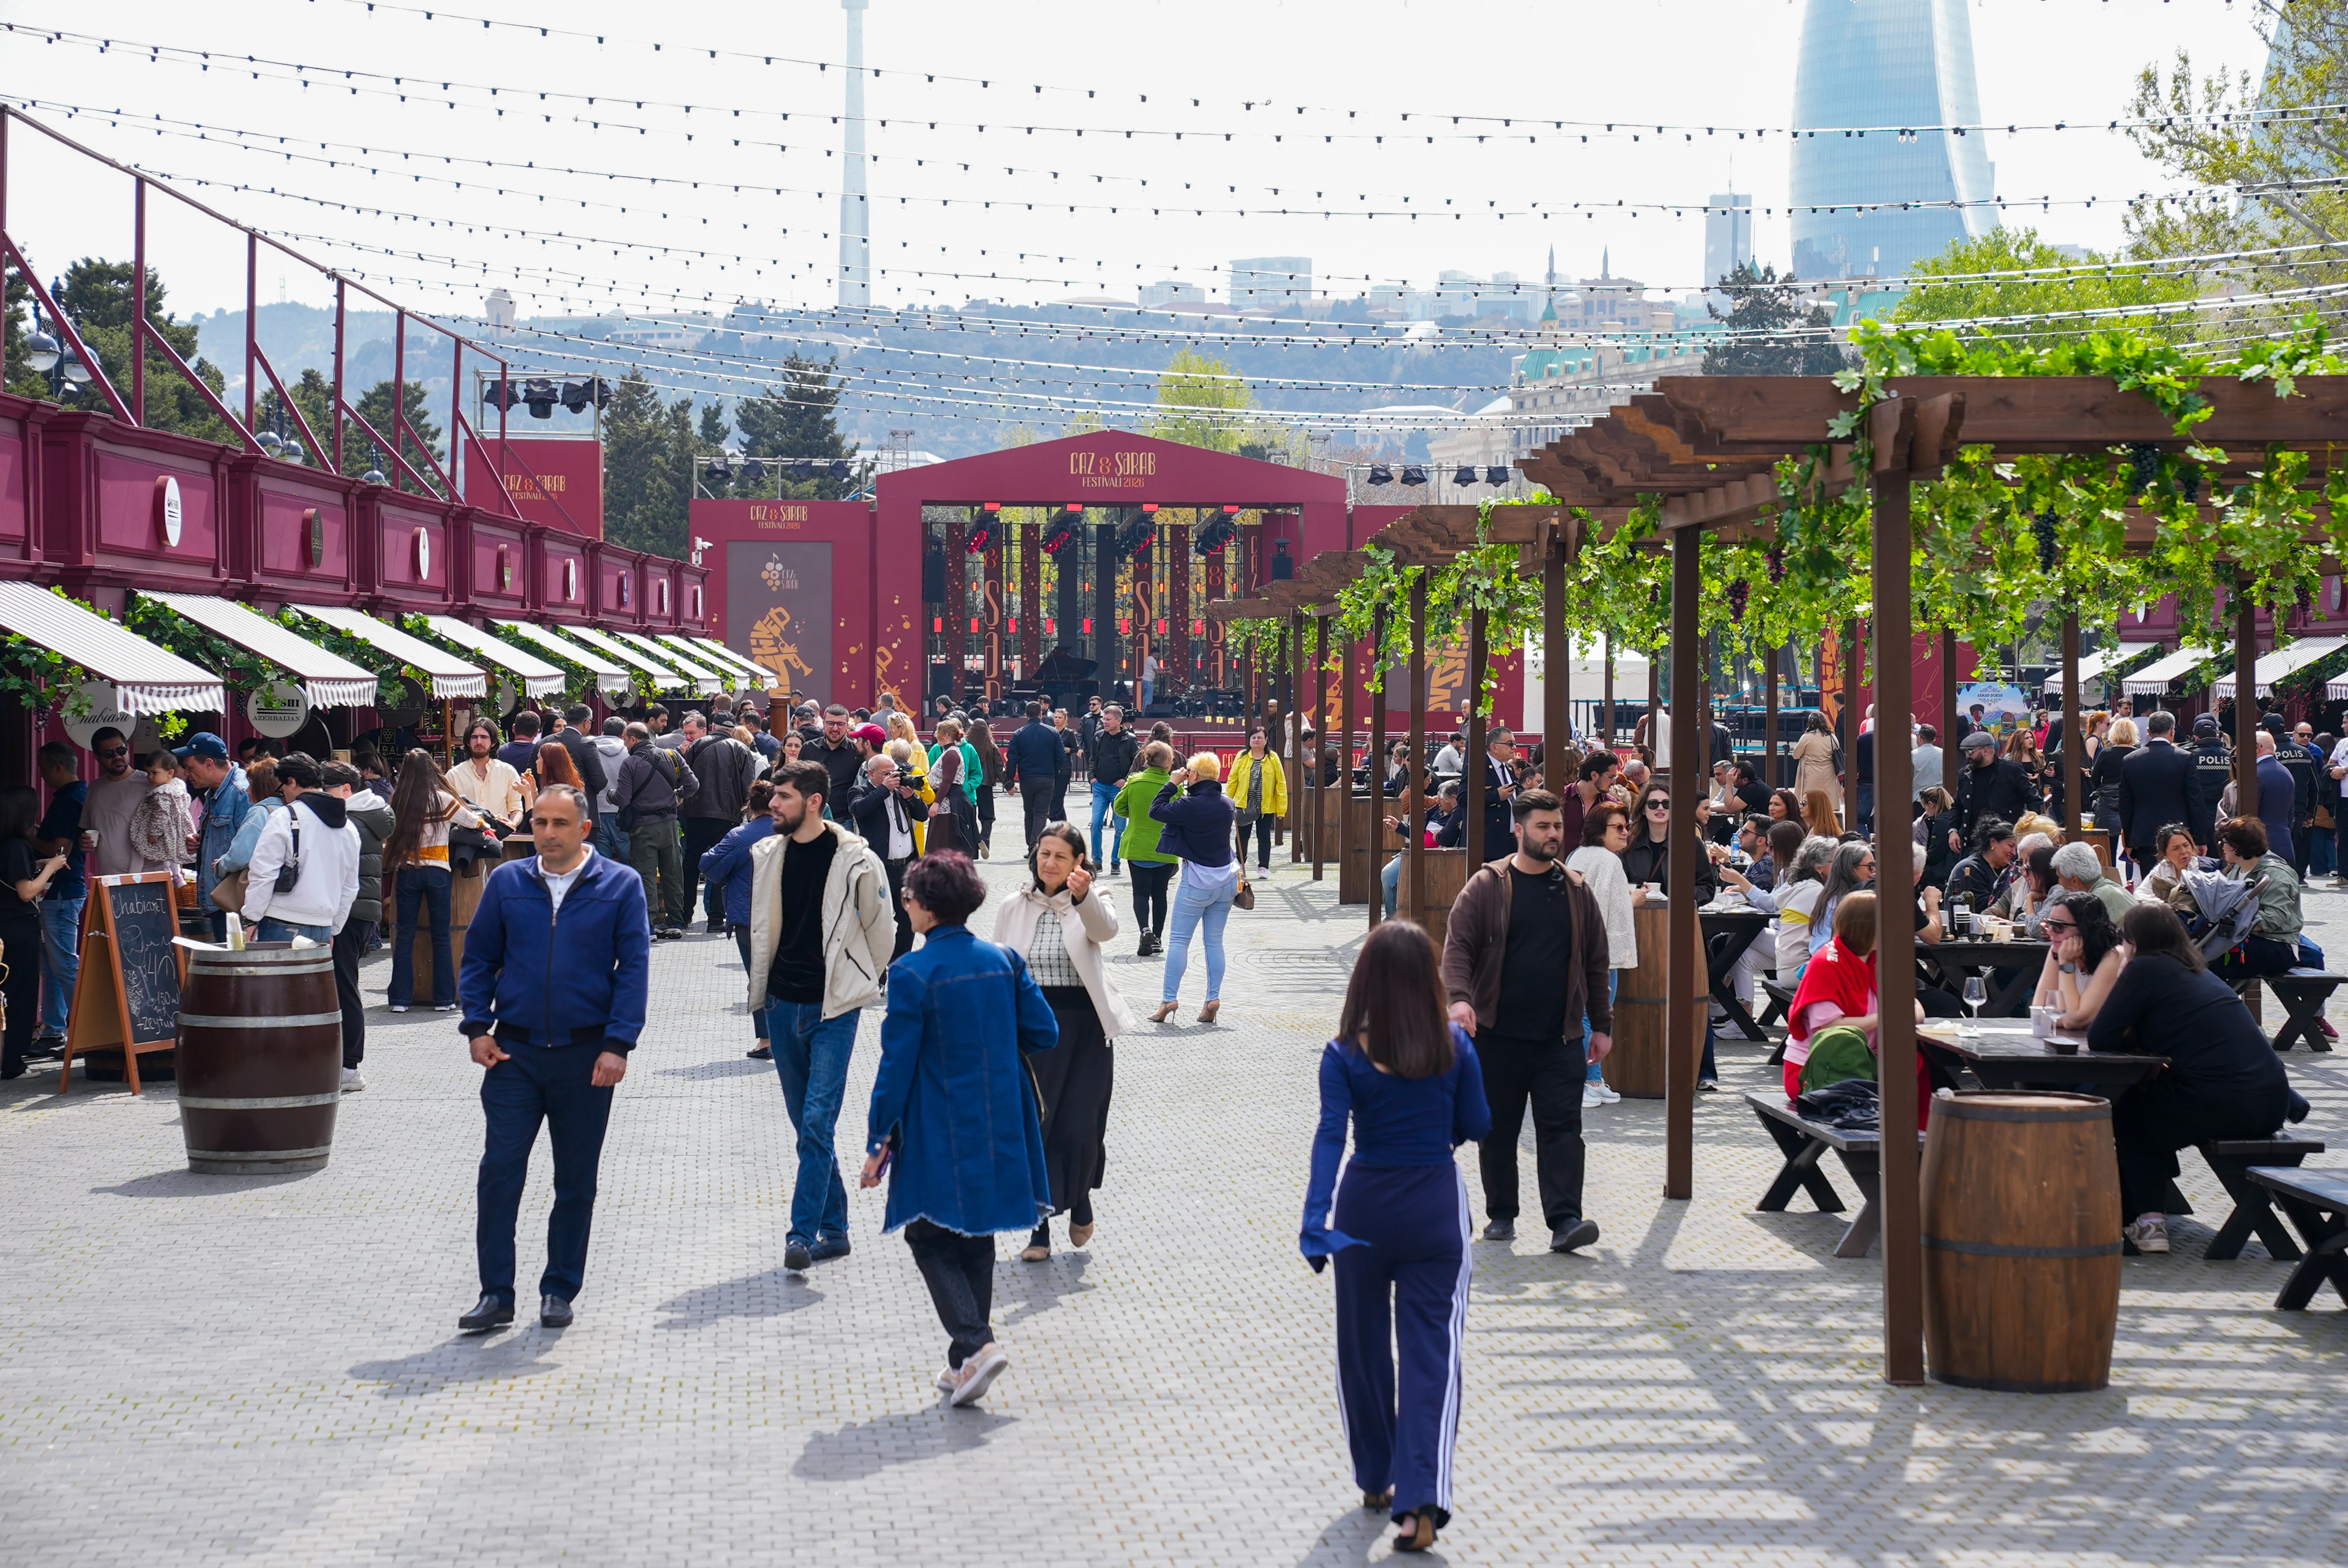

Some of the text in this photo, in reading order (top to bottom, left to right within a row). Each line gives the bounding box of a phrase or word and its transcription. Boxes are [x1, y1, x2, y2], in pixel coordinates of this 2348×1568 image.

[1070, 452, 1156, 476] CAZ & ŞƏRAB
[504, 475, 522, 491] CAZ
[525, 478, 534, 491] &
[1124, 477, 1144, 487] 2026
[750, 505, 808, 522] CAZ & ŞƏRAB
[1209, 566, 1223, 586] &
